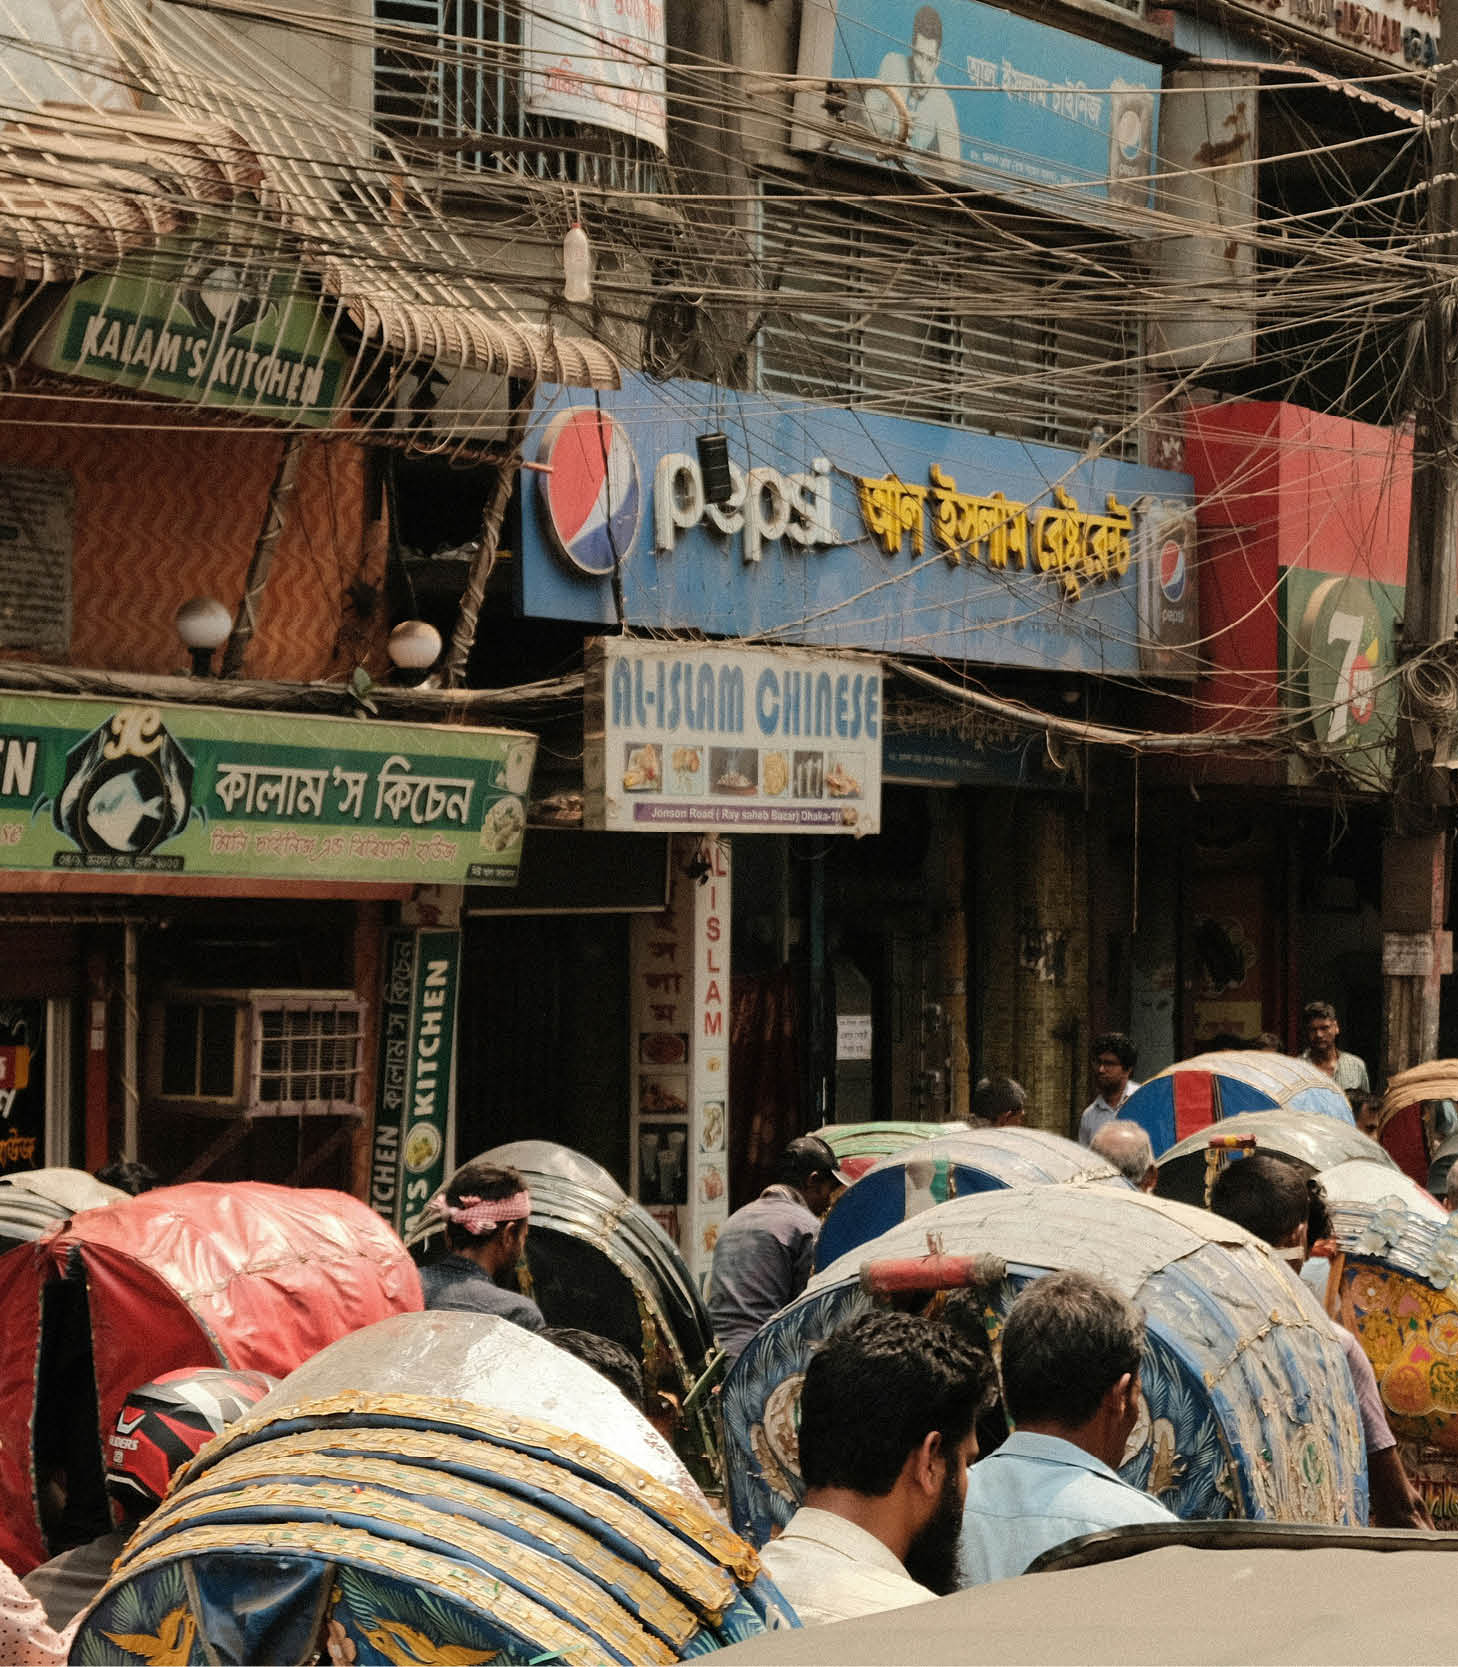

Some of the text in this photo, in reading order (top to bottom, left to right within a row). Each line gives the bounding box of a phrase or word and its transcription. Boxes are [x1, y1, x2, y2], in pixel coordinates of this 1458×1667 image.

[82, 315, 325, 405] KALAM'S KITCHEN
[653, 453, 833, 562] pepsi
[857, 472, 925, 557] আল
[927, 463, 1030, 568] ইসলাম
[611, 656, 745, 733] AL-ISLAM
[755, 667, 880, 740] CHINESE
[374, 754, 476, 825] কিচেন
[651, 807, 688, 820] Jonson
[689, 808, 714, 821] Road
[703, 886, 723, 1037] ISLAM
[413, 959, 450, 1117] KITCHEN
[371, 1124, 399, 1218] TCHEN
